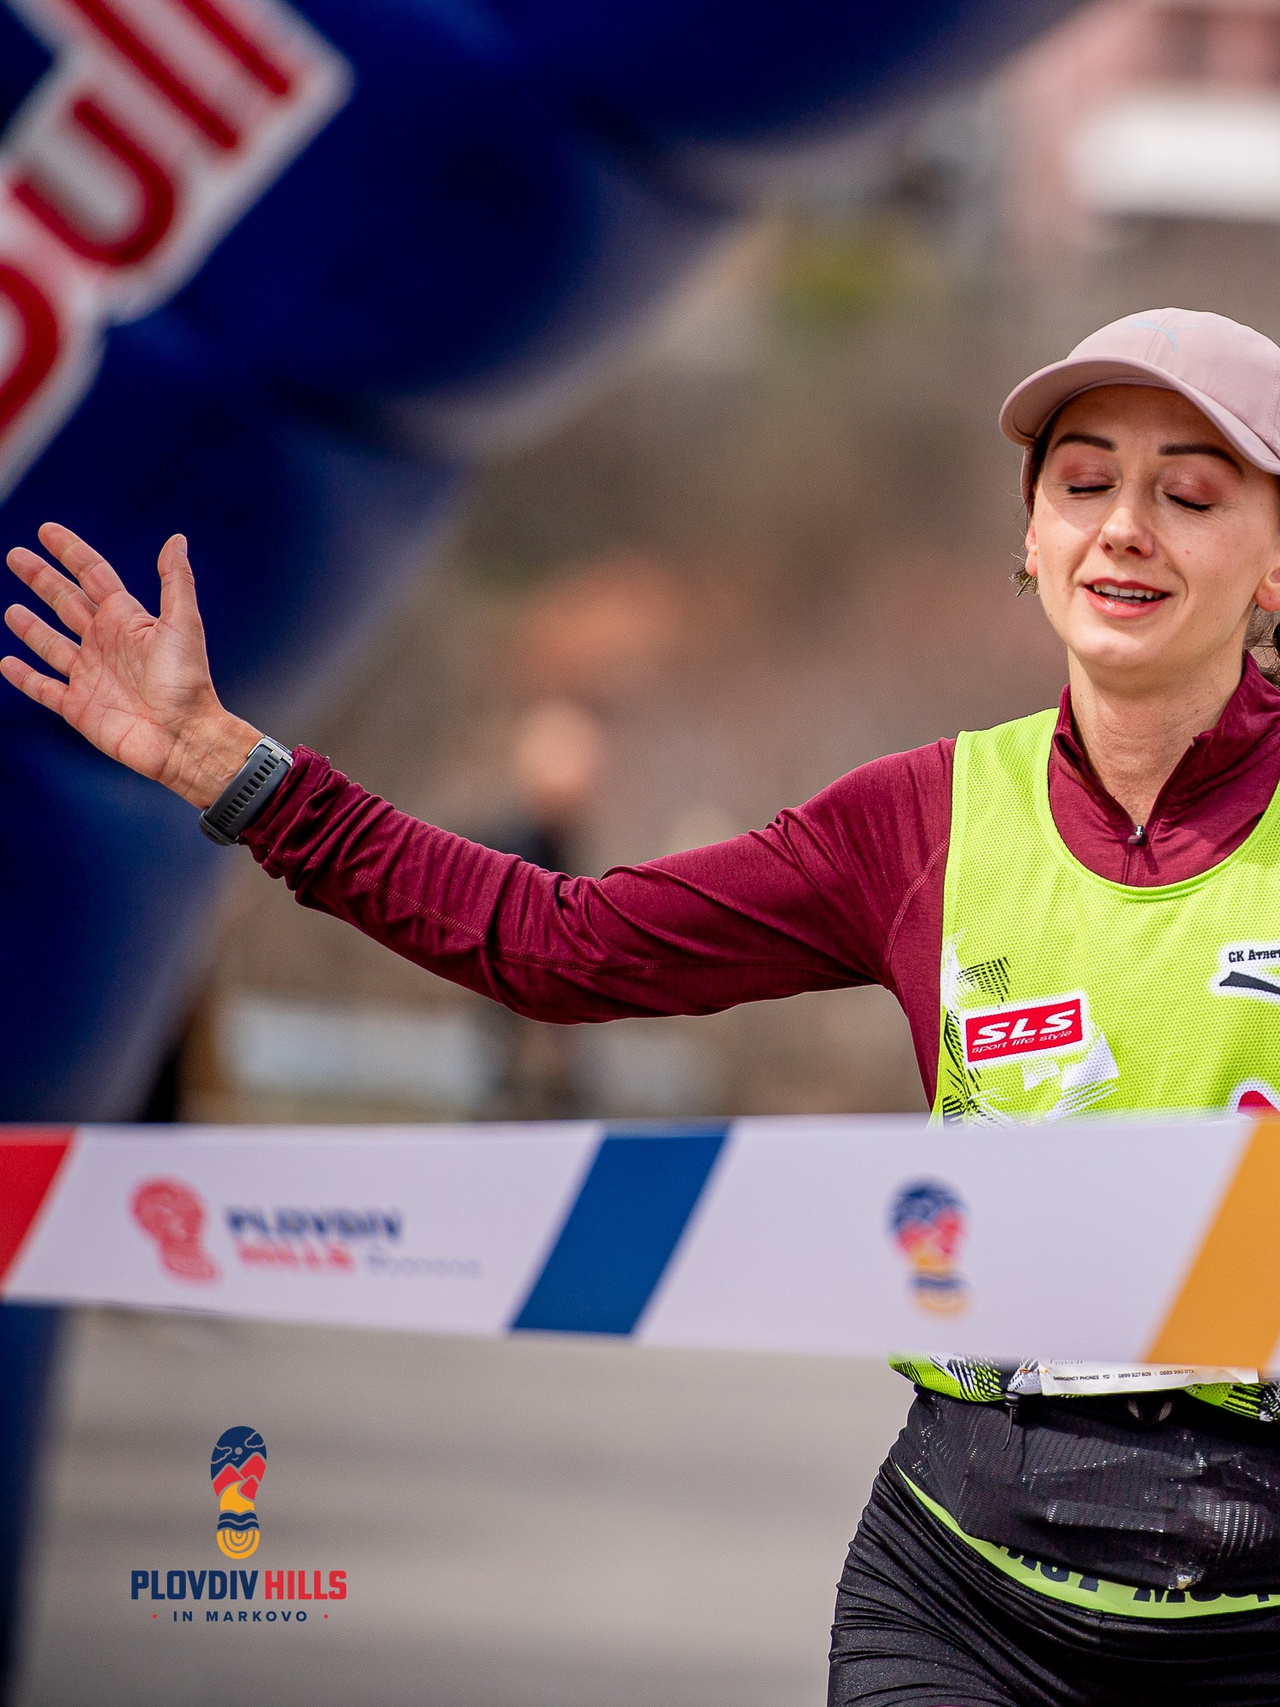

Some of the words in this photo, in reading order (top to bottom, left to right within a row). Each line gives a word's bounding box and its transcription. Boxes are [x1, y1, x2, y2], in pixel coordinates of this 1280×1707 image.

[1228, 951, 1245, 963] СК
[972, 1009, 1076, 1046] SLS
[971, 1041, 1008, 1054] sport
[1012, 1037, 1035, 1047] life
[1039, 1030, 1073, 1042] style
